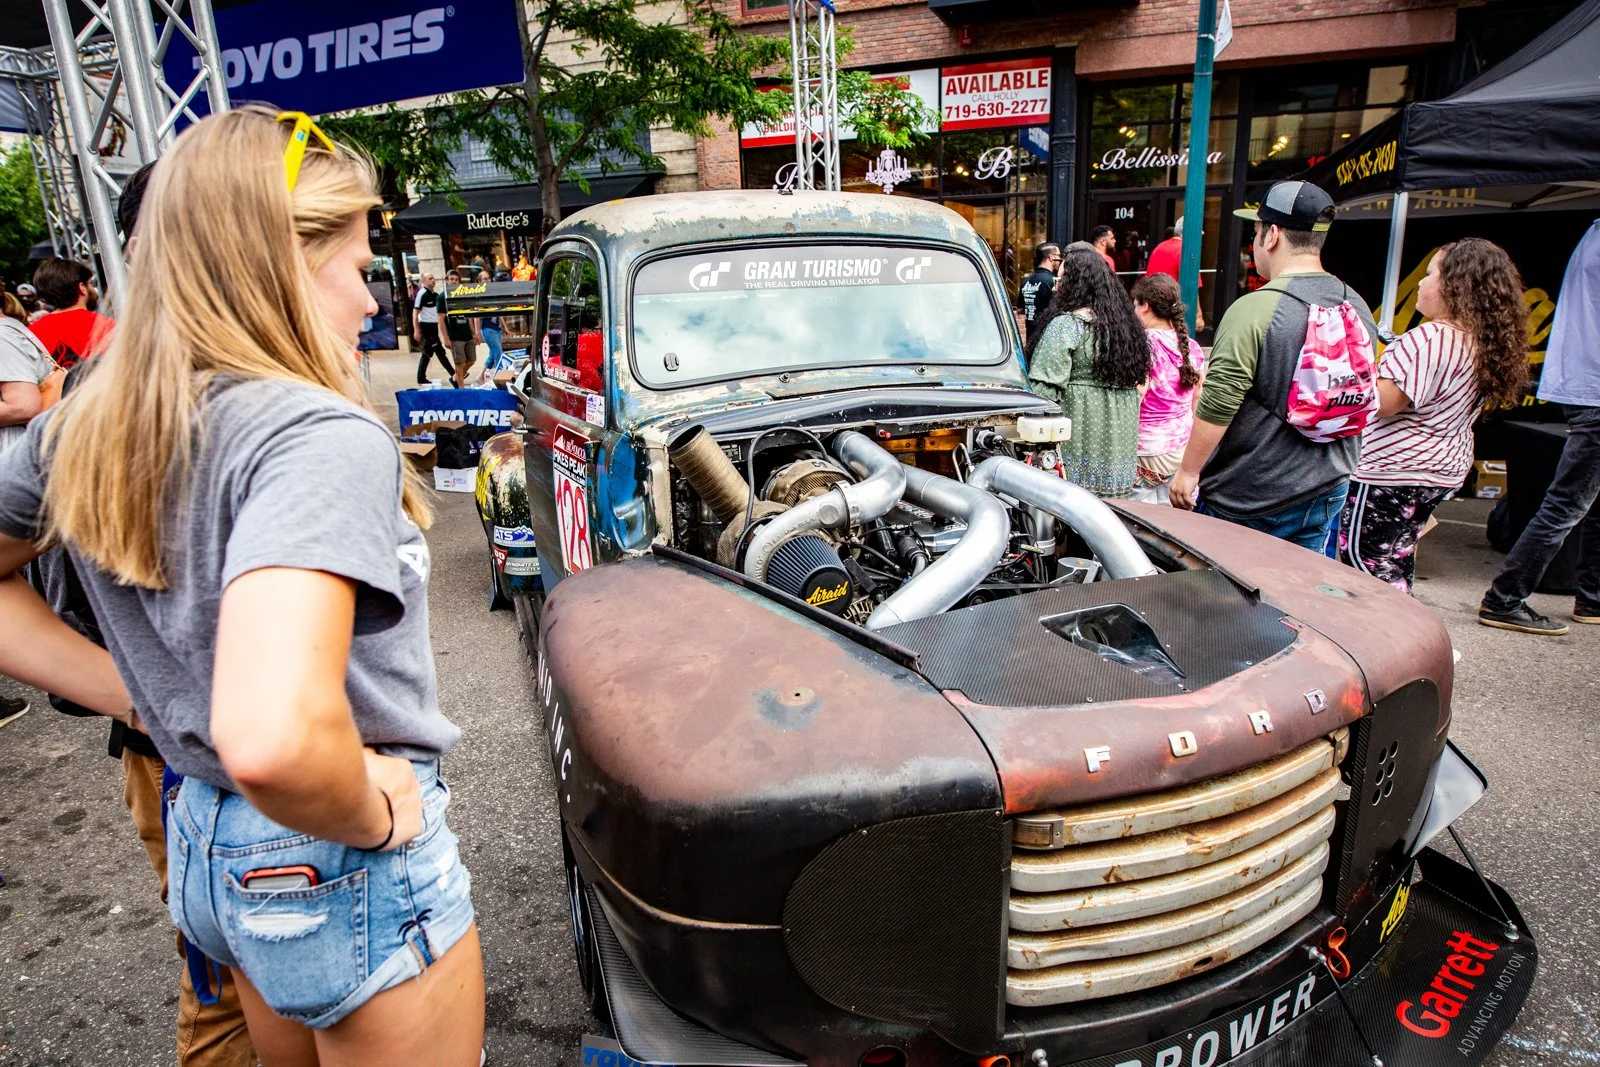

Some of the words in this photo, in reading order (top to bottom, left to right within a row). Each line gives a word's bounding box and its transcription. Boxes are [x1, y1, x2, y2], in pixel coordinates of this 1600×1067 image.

[192, 37, 303, 91] OYO
[945, 69, 1048, 95] AVAILABLE
[972, 94, 991, 103] CALL
[994, 91, 1019, 101] HOLLY
[945, 98, 1048, 119] 719-630-2277
[1100, 146, 1225, 170] Bellissia
[467, 211, 529, 230] Rutledge's
[1114, 206, 1134, 219] 104
[744, 260, 796, 280] GRAN
[450, 282, 487, 298] Airaid
[744, 281, 763, 289] THE
[764, 280, 789, 288] REAL
[791, 279, 828, 288] DRIVING
[830, 277, 880, 286] SIMULATOR
[1323, 391, 1364, 412] plus
[569, 457, 586, 478] PEAK
[556, 474, 592, 572] 128
[495, 529, 513, 541] ATS
[806, 581, 848, 607] Airaid
[1084, 689, 1327, 772] FORD
[552, 702, 571, 803] INC.
[1396, 929, 1499, 1038] Garrett
[1457, 992, 1503, 1056] ADVANCING
[1495, 952, 1526, 991] MOTION
